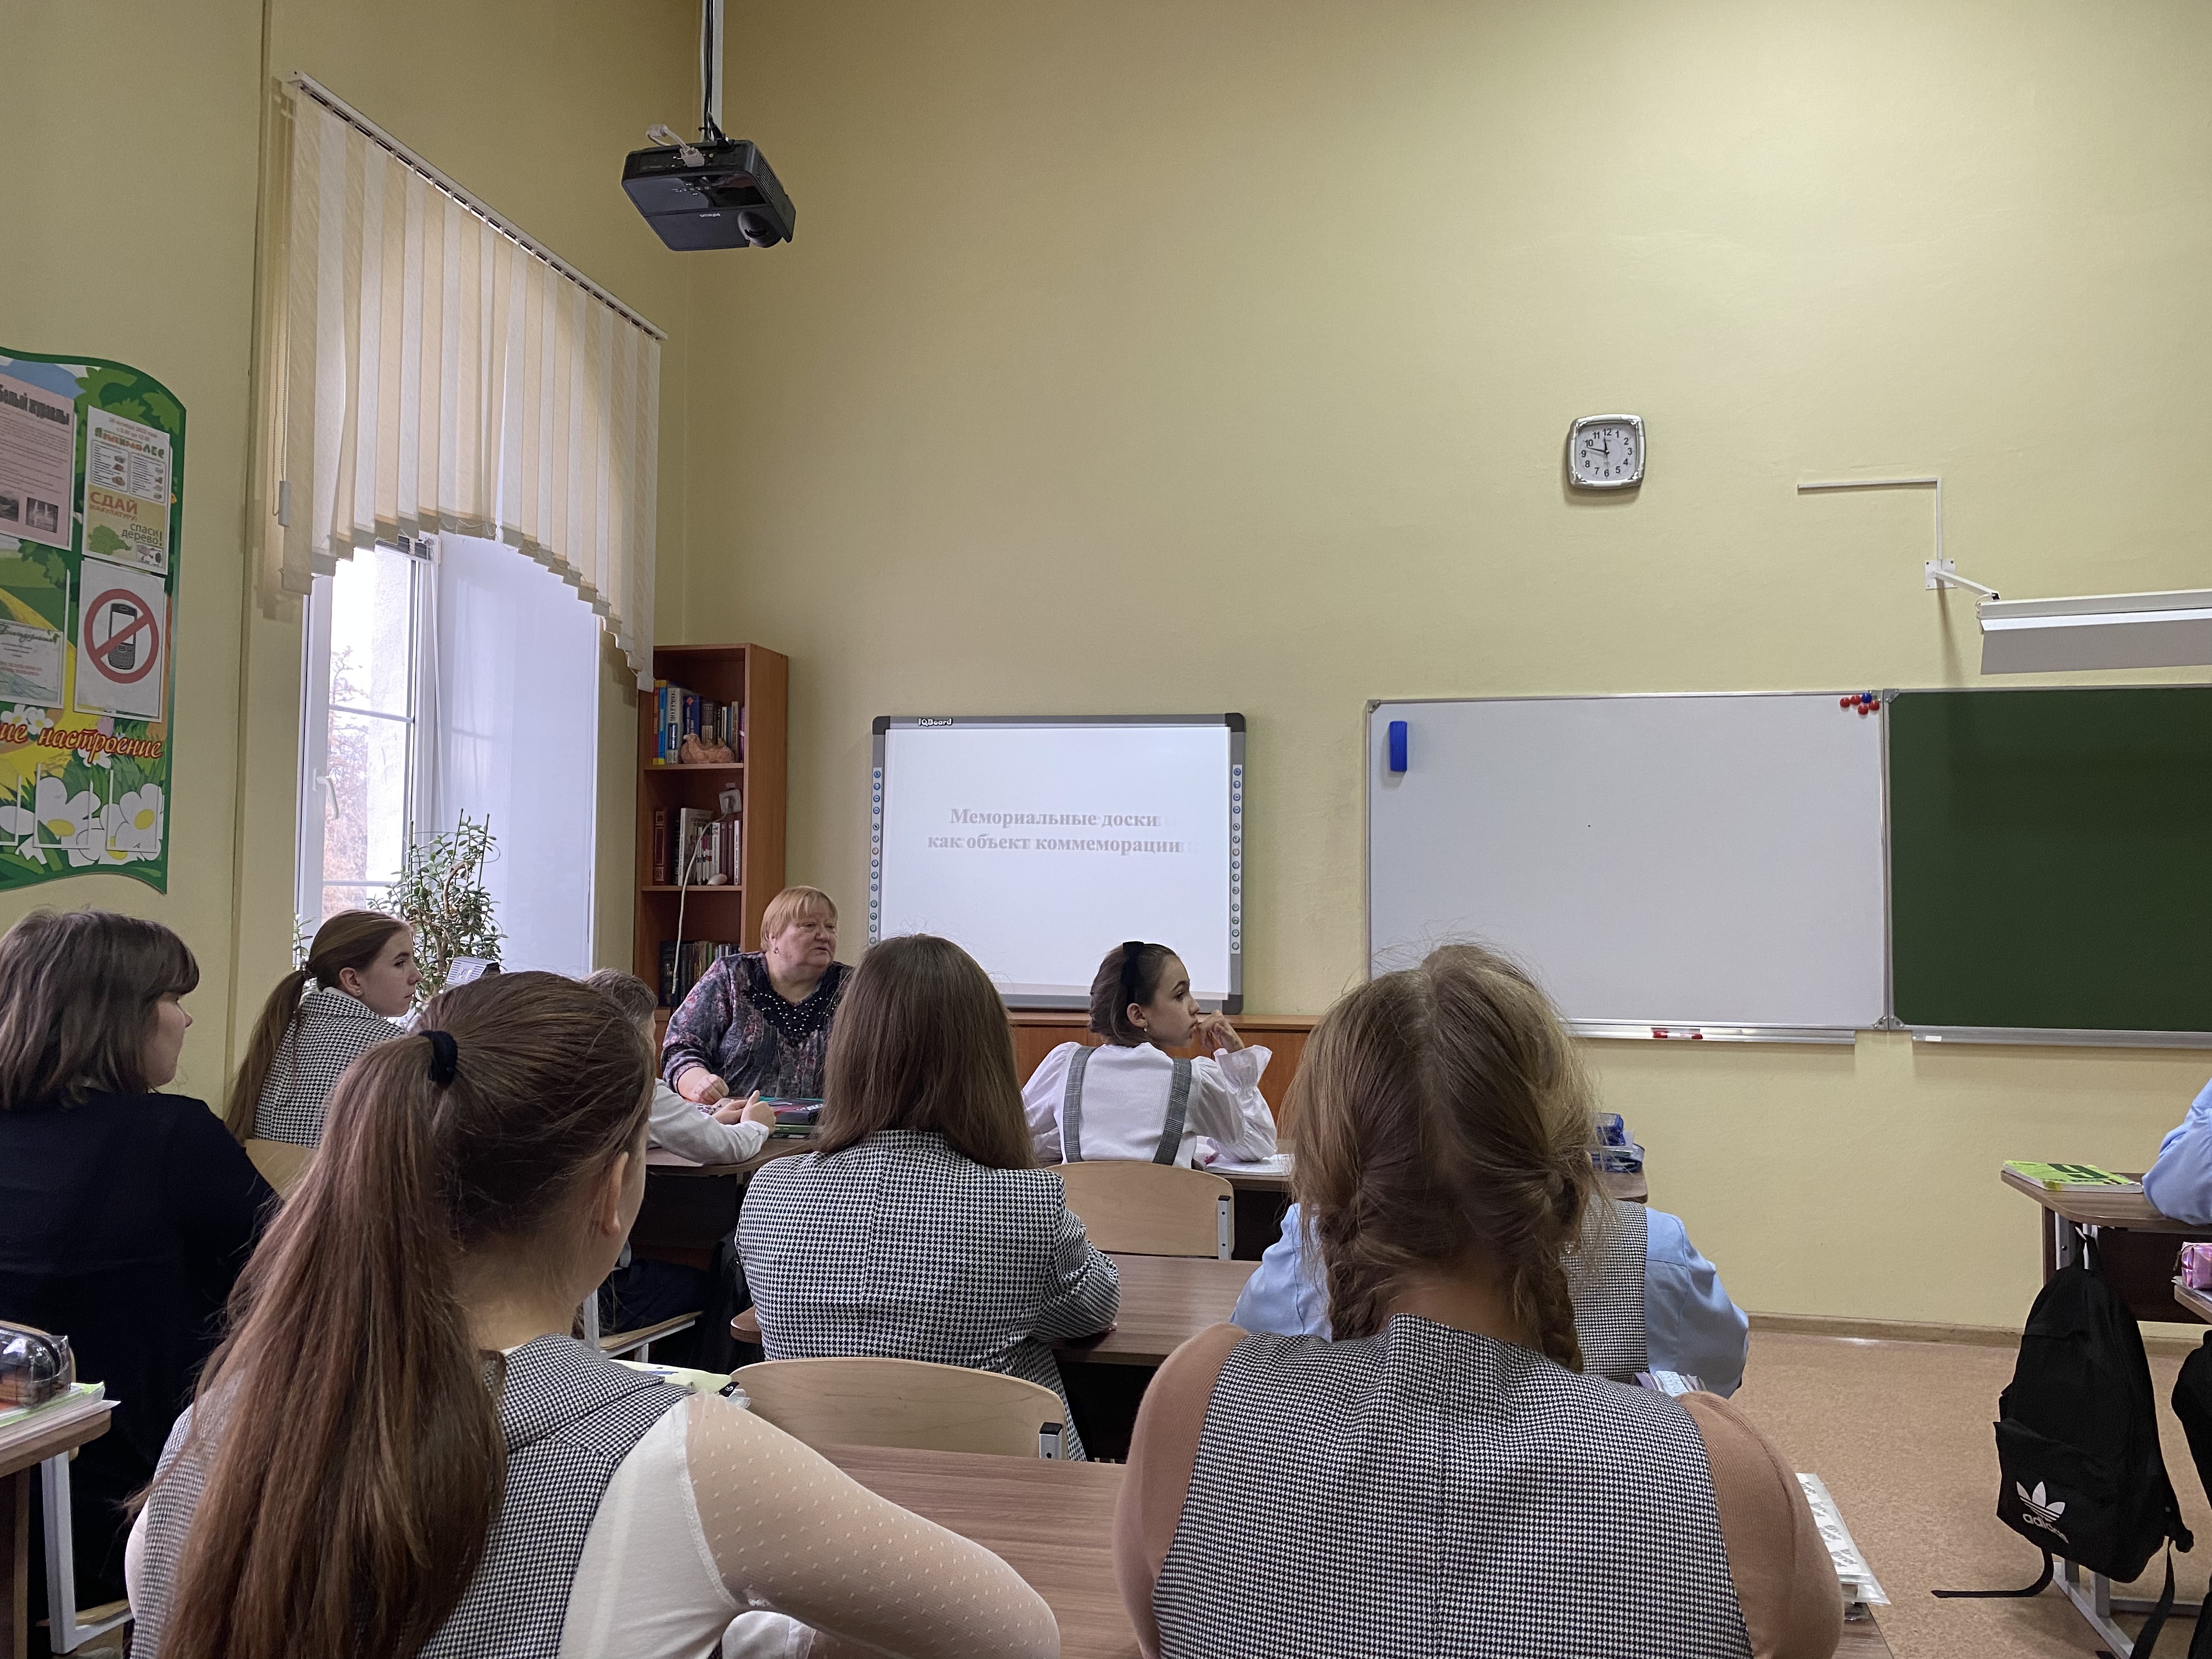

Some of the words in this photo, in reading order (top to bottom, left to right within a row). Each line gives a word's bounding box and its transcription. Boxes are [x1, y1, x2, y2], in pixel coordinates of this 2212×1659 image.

[90, 491, 138, 515] СДАЙ
[130, 523, 159, 537] спаси
[917, 718, 953, 727] IQBoard
[37, 727, 163, 764] настроение
[950, 808, 1097, 829] Мемориальные
[1101, 814, 1159, 828] доски
[927, 837, 962, 849] как
[966, 833, 1030, 849] объект
[1035, 838, 1182, 856] коммеморации
